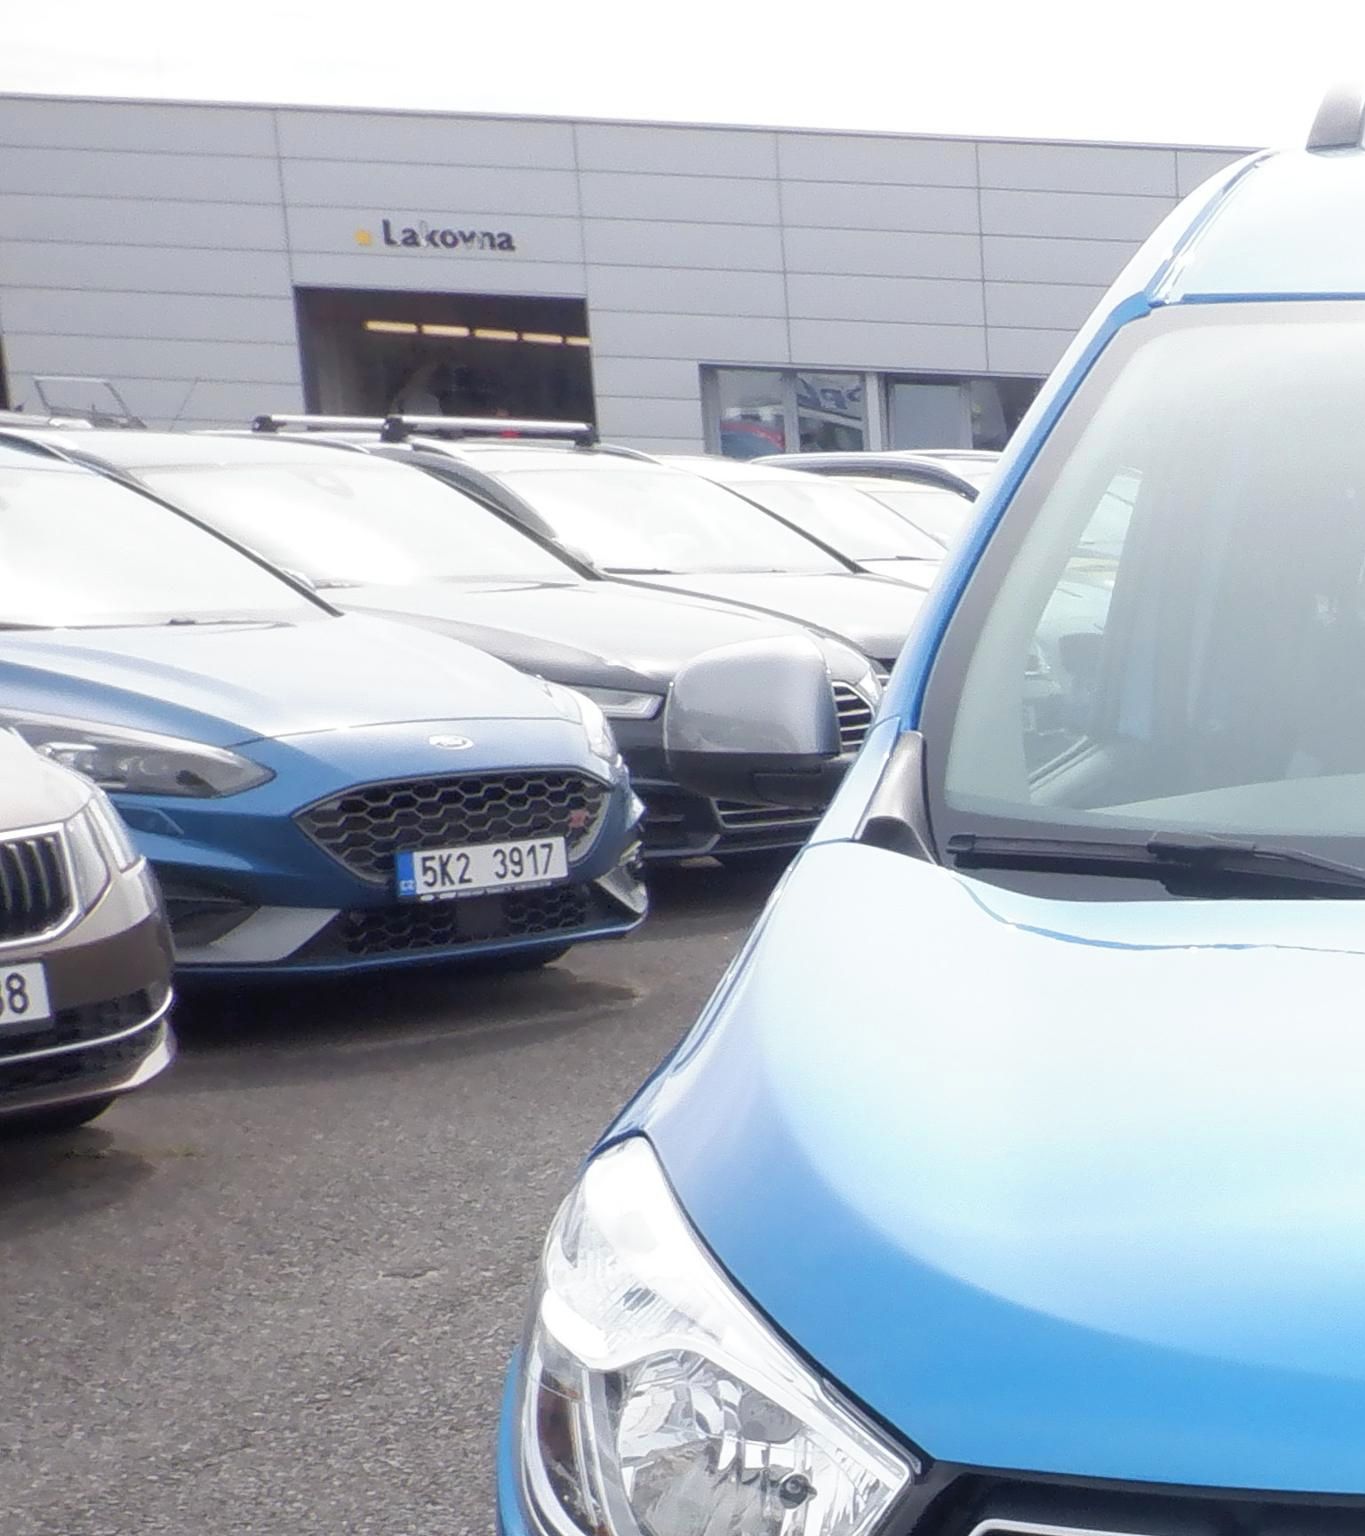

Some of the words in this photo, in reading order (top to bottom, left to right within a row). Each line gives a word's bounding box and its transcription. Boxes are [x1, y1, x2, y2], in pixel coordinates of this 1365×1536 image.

[382, 219, 516, 252] Lakovna
[421, 853, 474, 887] 5K2
[493, 842, 553, 879] 3917
[0, 972, 29, 1014] 8
